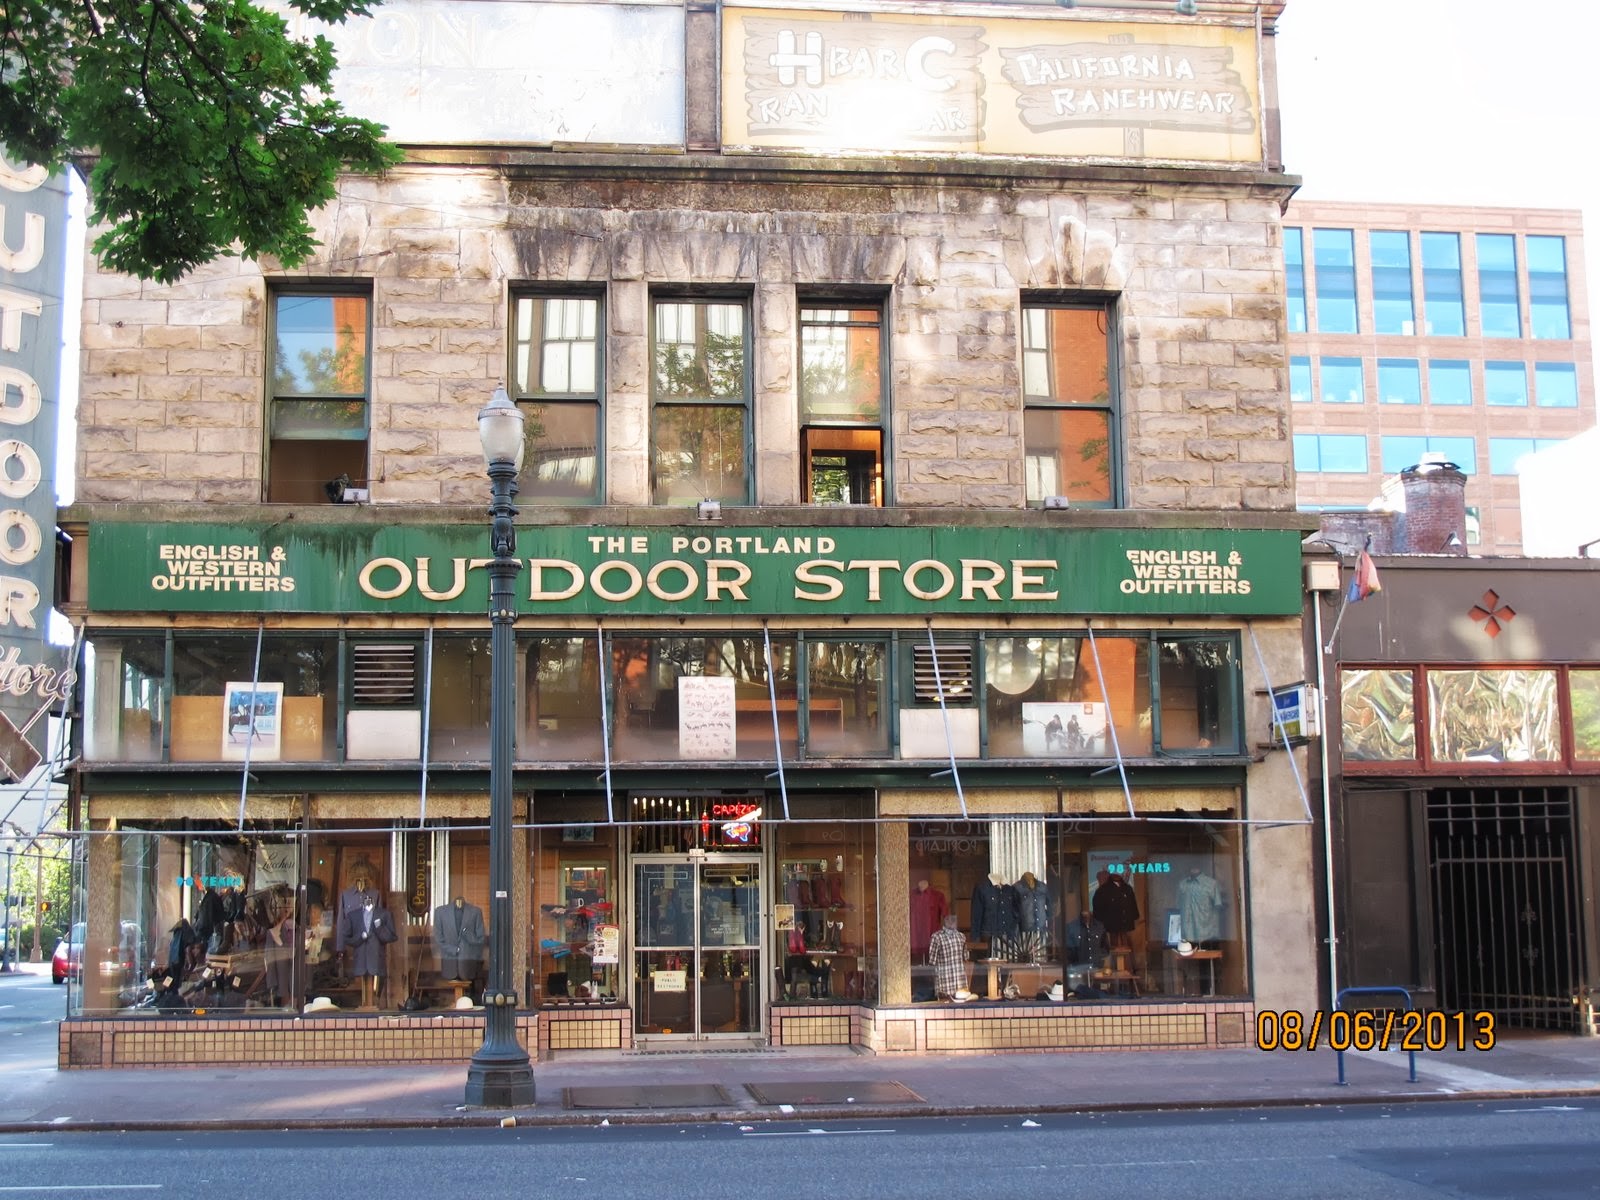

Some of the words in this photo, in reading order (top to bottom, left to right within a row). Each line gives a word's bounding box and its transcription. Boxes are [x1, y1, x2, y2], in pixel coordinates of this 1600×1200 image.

[769, 29, 822, 88] H
[829, 45, 900, 80] BAR
[904, 35, 959, 91] C
[1015, 53, 1197, 86] CALIFORNIA
[1052, 87, 1236, 116] RANCHWEAR
[758, 90, 968, 132] RANAR
[159, 545, 259, 561] ENGLISH
[271, 545, 288, 562] &
[588, 536, 648, 553] THE
[672, 536, 836, 554] PORTLAND
[1126, 550, 1217, 564] ENGLISH
[1227, 550, 1243, 565] &
[167, 560, 281, 577] WESTERN
[1132, 565, 1238, 580] WESTERN
[151, 575, 296, 592] OUTFITTERS
[794, 558, 1060, 602] STORE
[1120, 579, 1251, 594] OUTFITTERS
[0, 645, 78, 700] tore
[1108, 863, 1125, 874] 98
[1129, 862, 1171, 873] YEARS
